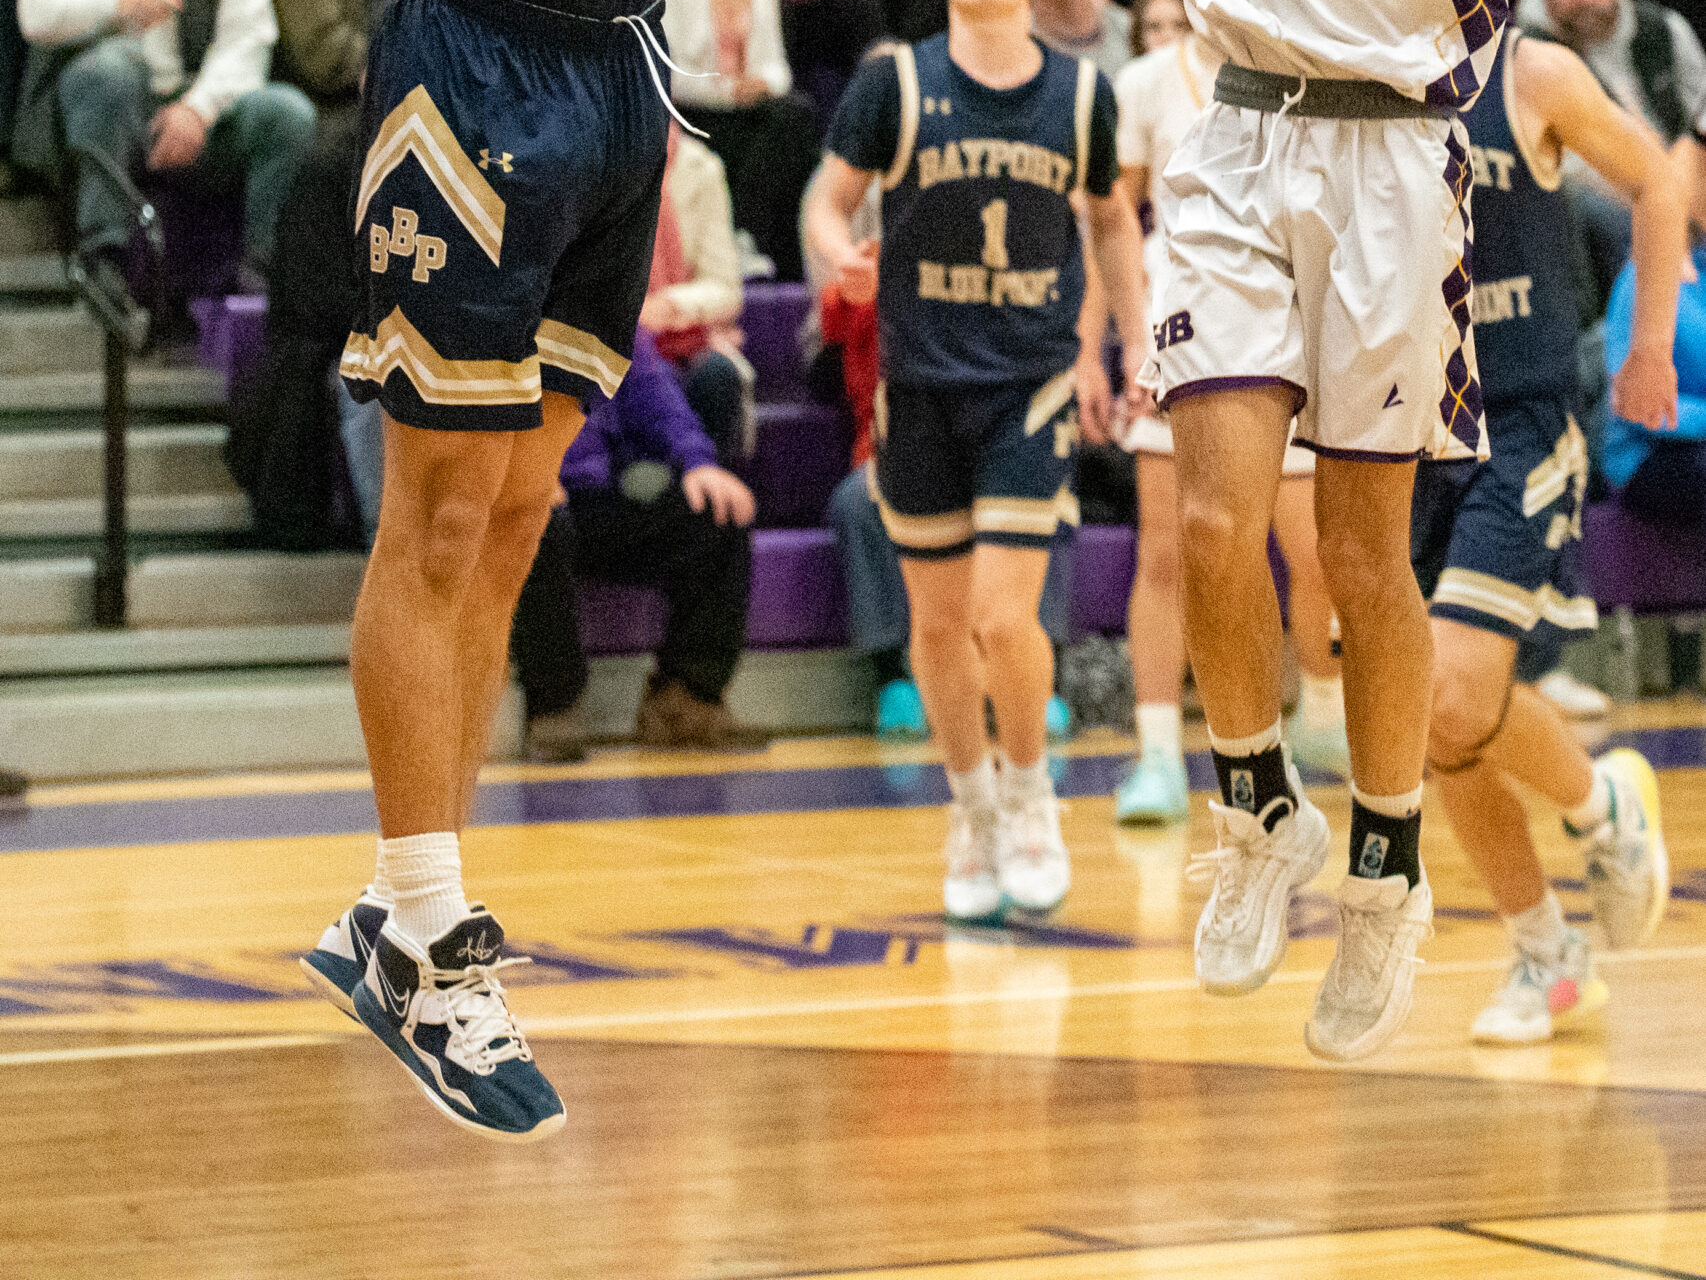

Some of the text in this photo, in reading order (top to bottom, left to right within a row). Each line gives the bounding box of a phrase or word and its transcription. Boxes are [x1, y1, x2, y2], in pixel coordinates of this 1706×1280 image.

[369, 206, 448, 283] BBP
[980, 198, 1010, 269] 1
[918, 260, 988, 305] BLUE
